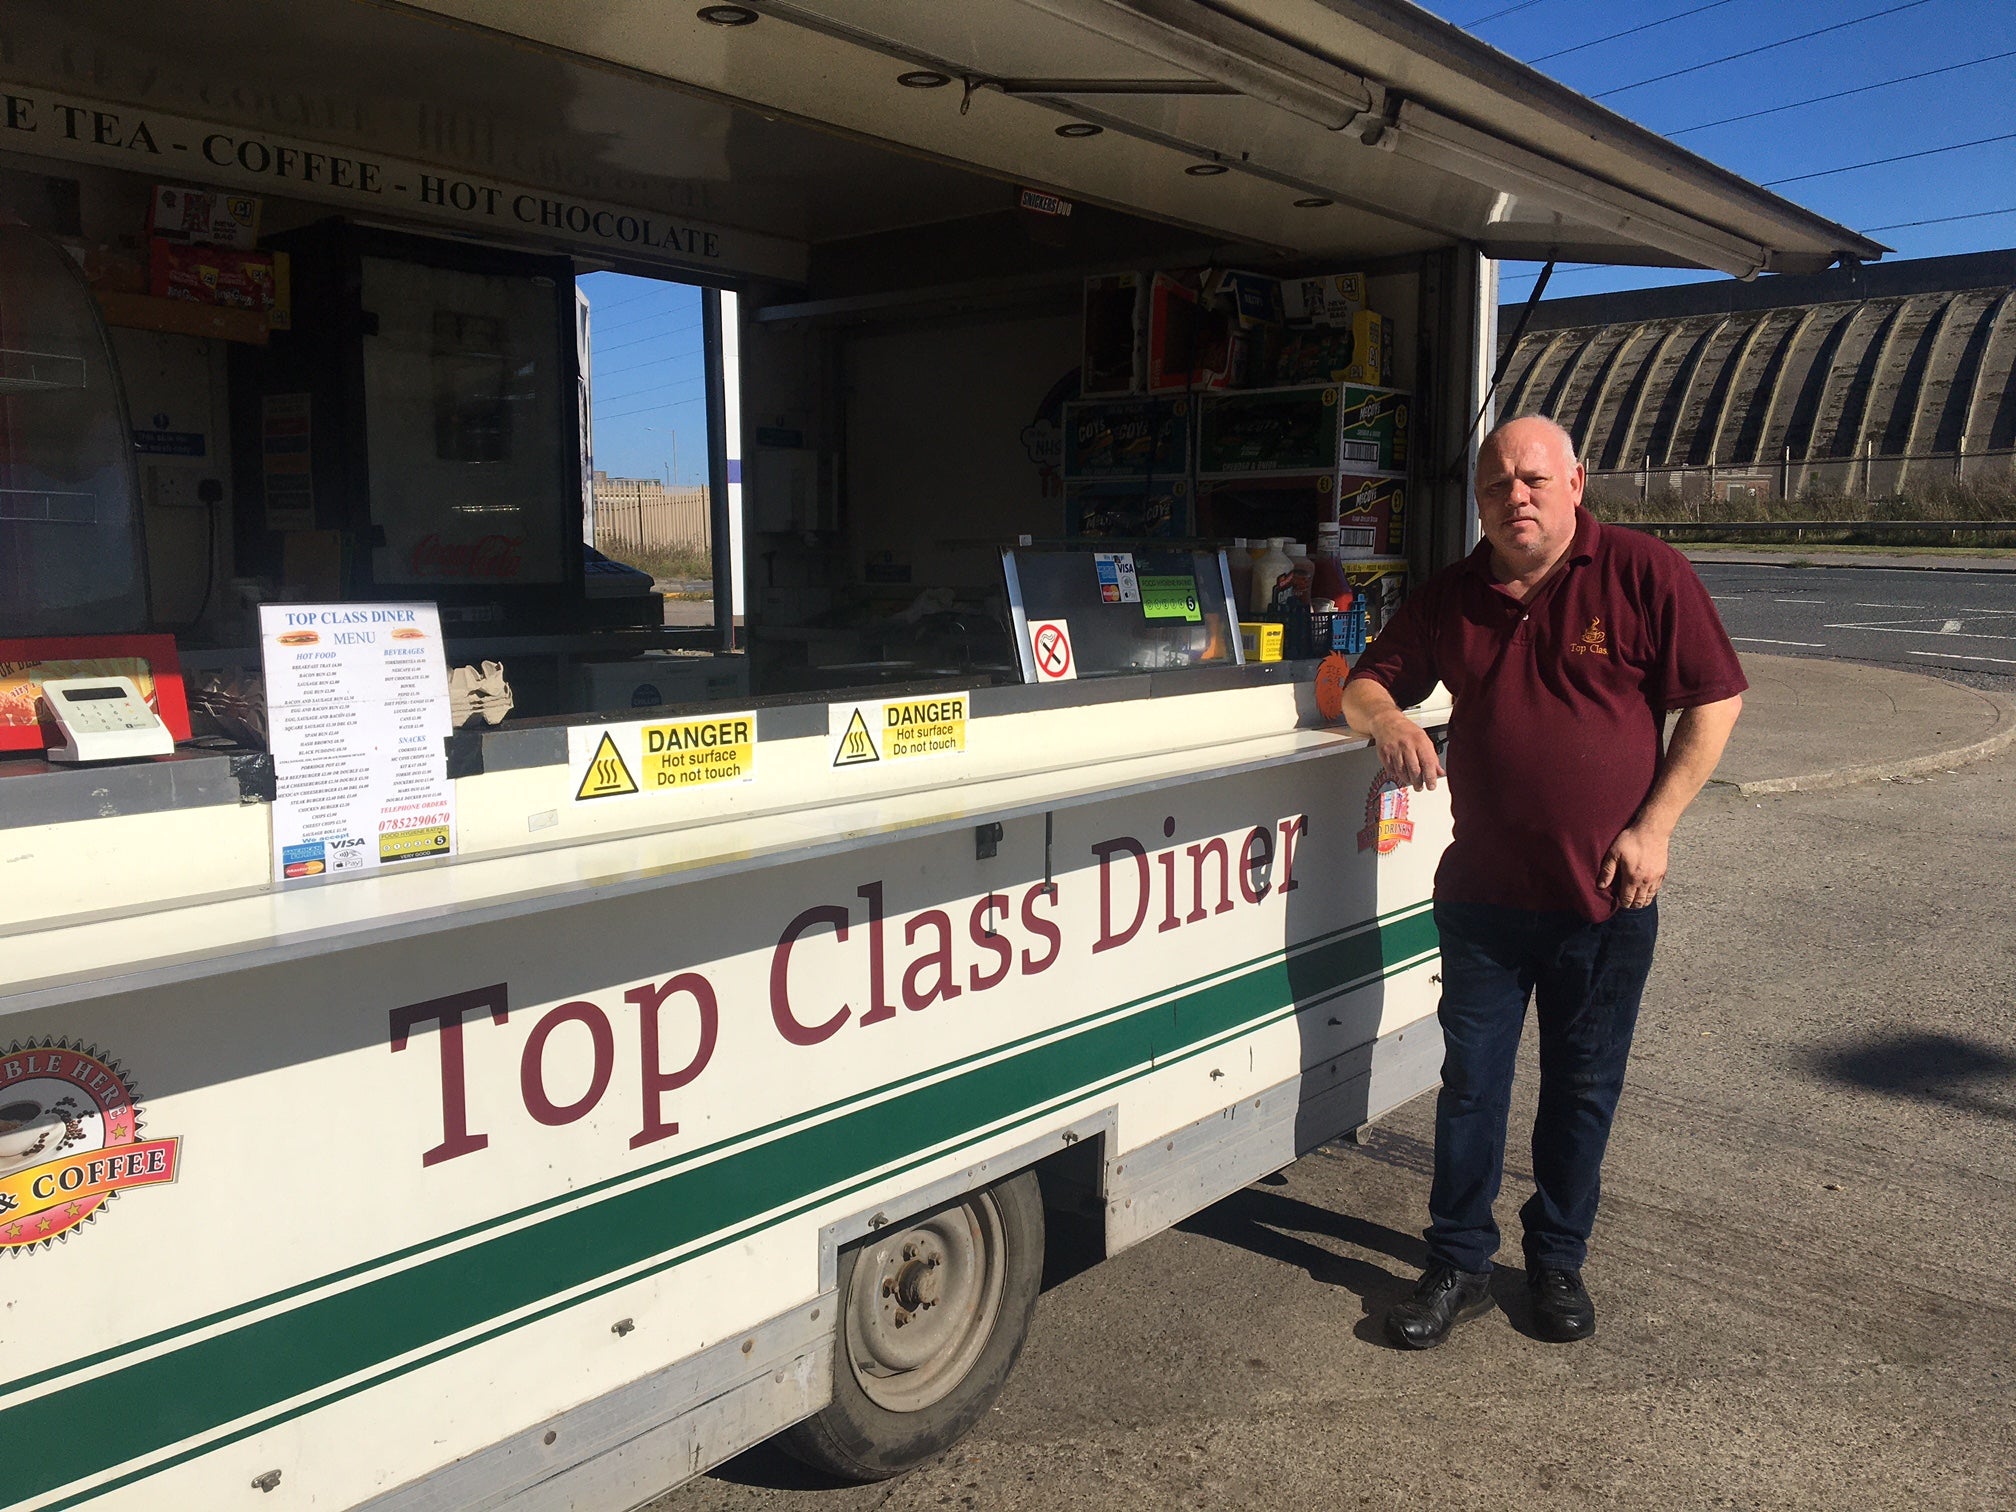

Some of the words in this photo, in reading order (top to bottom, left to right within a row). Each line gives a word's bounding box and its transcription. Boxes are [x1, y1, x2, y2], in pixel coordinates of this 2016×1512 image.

[53, 104, 161, 154] TEA
[202, 134, 382, 193] COFFEE
[419, 174, 502, 215] HOT
[513, 194, 720, 258] CHOCOLATE
[1117, 564, 1134, 573] VISA
[1188, 598, 1195, 611] 5
[286, 613, 317, 626] TOP
[321, 611, 368, 624] CLASS
[372, 610, 415, 622] DINER
[334, 632, 376, 645] MENU
[384, 648, 425, 656] BEVERAGES
[1570, 643, 1586, 654] Top
[888, 700, 963, 727] DANGER
[399, 736, 426, 744] SNACKS
[648, 721, 748, 753] DANGER
[896, 726, 915, 741] Hot
[918, 723, 954, 737] surface
[893, 743, 908, 756] Do
[910, 740, 929, 754] not
[931, 737, 956, 751] touch
[661, 753, 685, 768] Hot
[689, 748, 737, 764] surface
[657, 771, 676, 786] Do
[679, 769, 701, 783] not
[705, 764, 741, 780] touch
[380, 804, 420, 814] TELEPHONE
[422, 801, 447, 809] ORDERS
[379, 812, 450, 831] 07852290670
[318, 833, 349, 841] accept
[330, 838, 365, 849] VISA
[388, 971, 720, 1168] Top
[767, 880, 1064, 1047] Class
[1090, 813, 1309, 956] Diner
[0, 1055, 62, 1085] BLE
[72, 1060, 128, 1120] HERE
[32, 1149, 166, 1200] COFFEE
